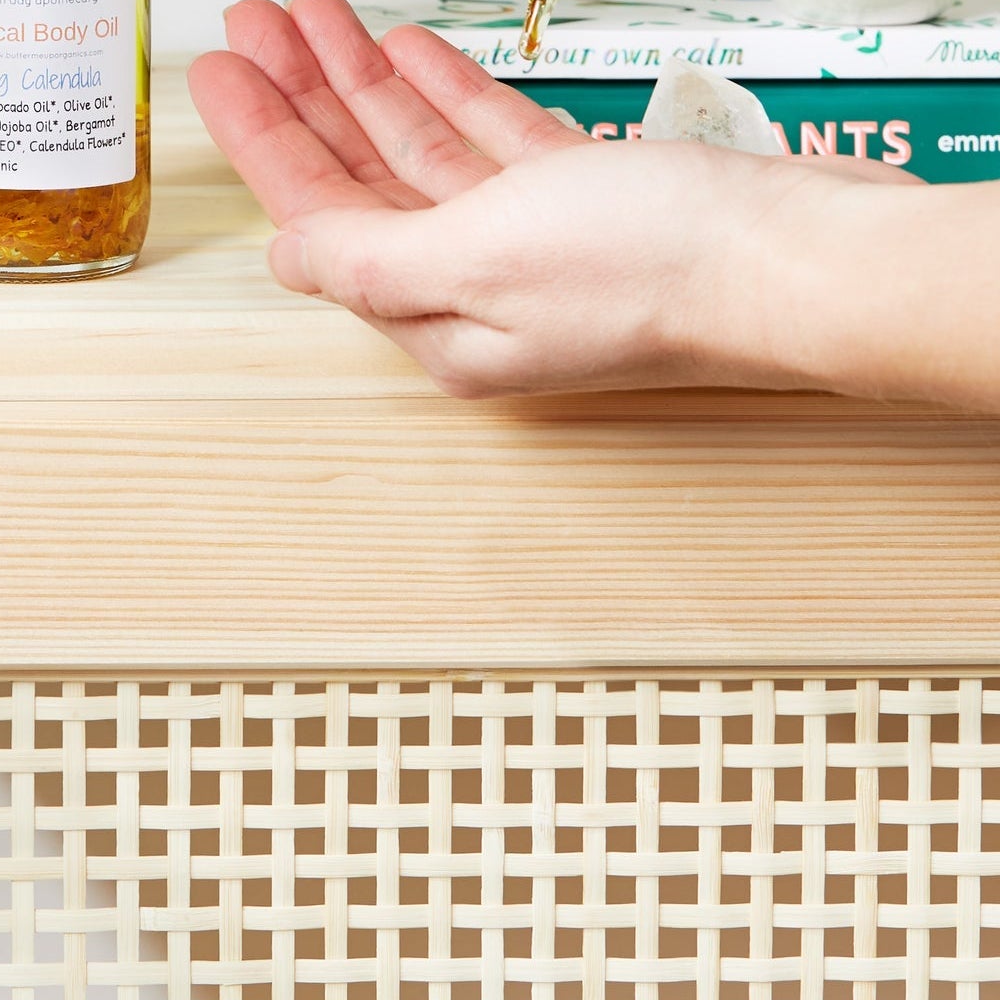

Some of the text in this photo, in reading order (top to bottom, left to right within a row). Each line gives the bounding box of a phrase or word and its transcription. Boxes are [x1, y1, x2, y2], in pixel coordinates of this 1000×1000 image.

[34, 21, 88, 45] Body
[95, 17, 118, 38] Oil
[461, 38, 517, 66] ate
[603, 47, 661, 66] own
[925, 39, 1000, 63] Meera
[22, 65, 102, 90] Calendula
[63, 99, 91, 112] Olive
[66, 115, 115, 135] Bergamot
[29, 140, 85, 152] Calendula
[938, 134, 1000, 153] emm
